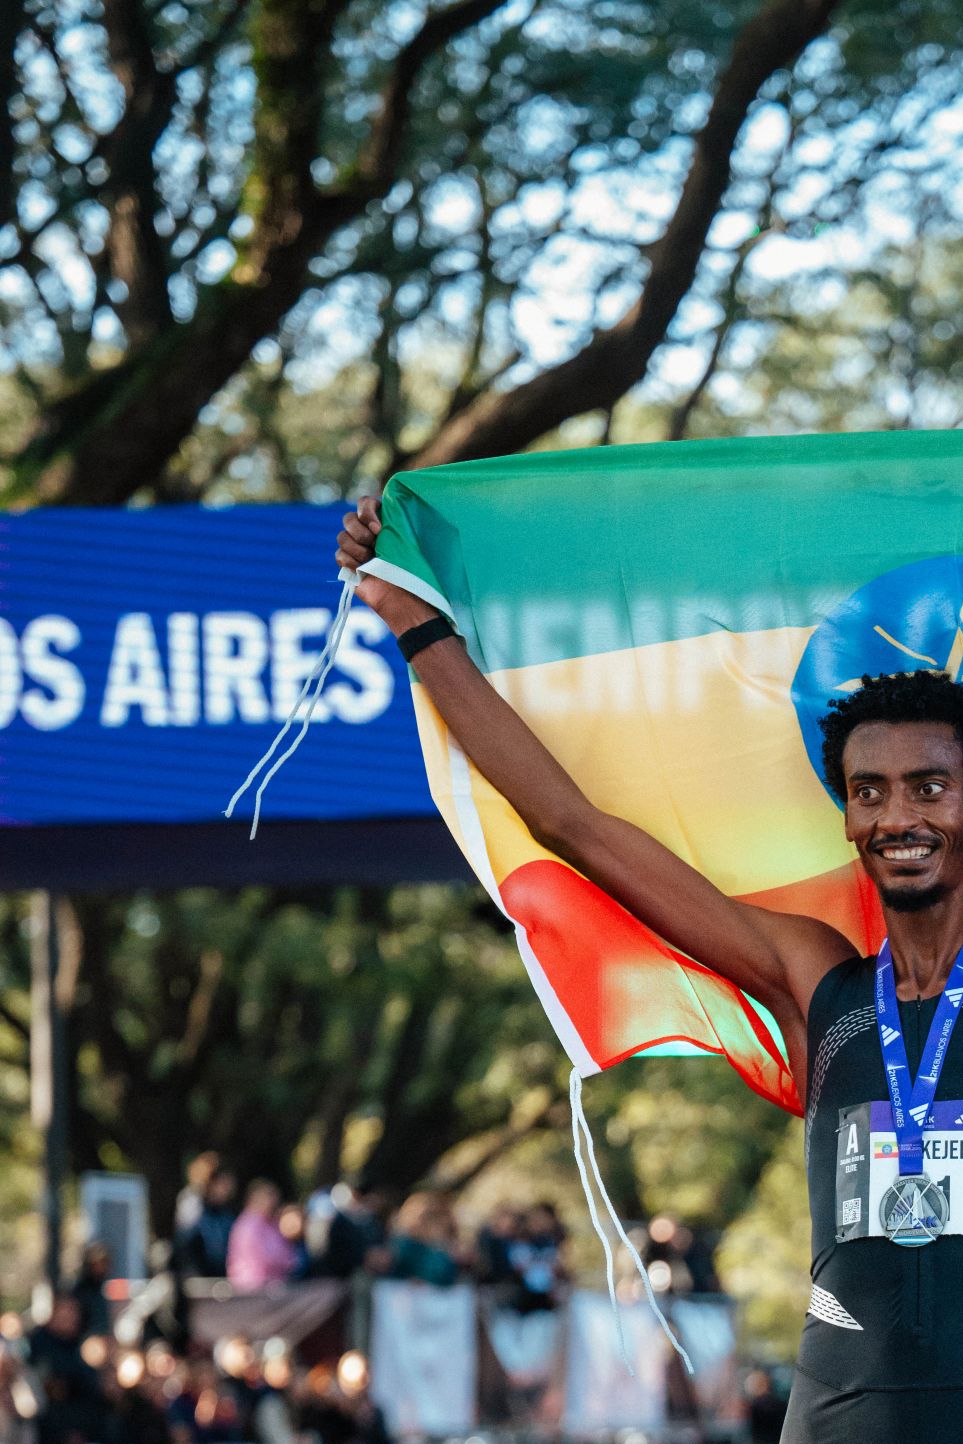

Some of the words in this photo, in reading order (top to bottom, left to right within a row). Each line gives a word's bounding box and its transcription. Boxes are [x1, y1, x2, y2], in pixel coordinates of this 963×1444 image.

[101, 606, 395, 728] AIRES
[941, 1018, 953, 1038] AIRES
[894, 1107, 905, 1128] AIRES
[846, 1123, 859, 1156] A
[845, 1164, 858, 1174] ELITE
[937, 1175, 950, 1222] 1
